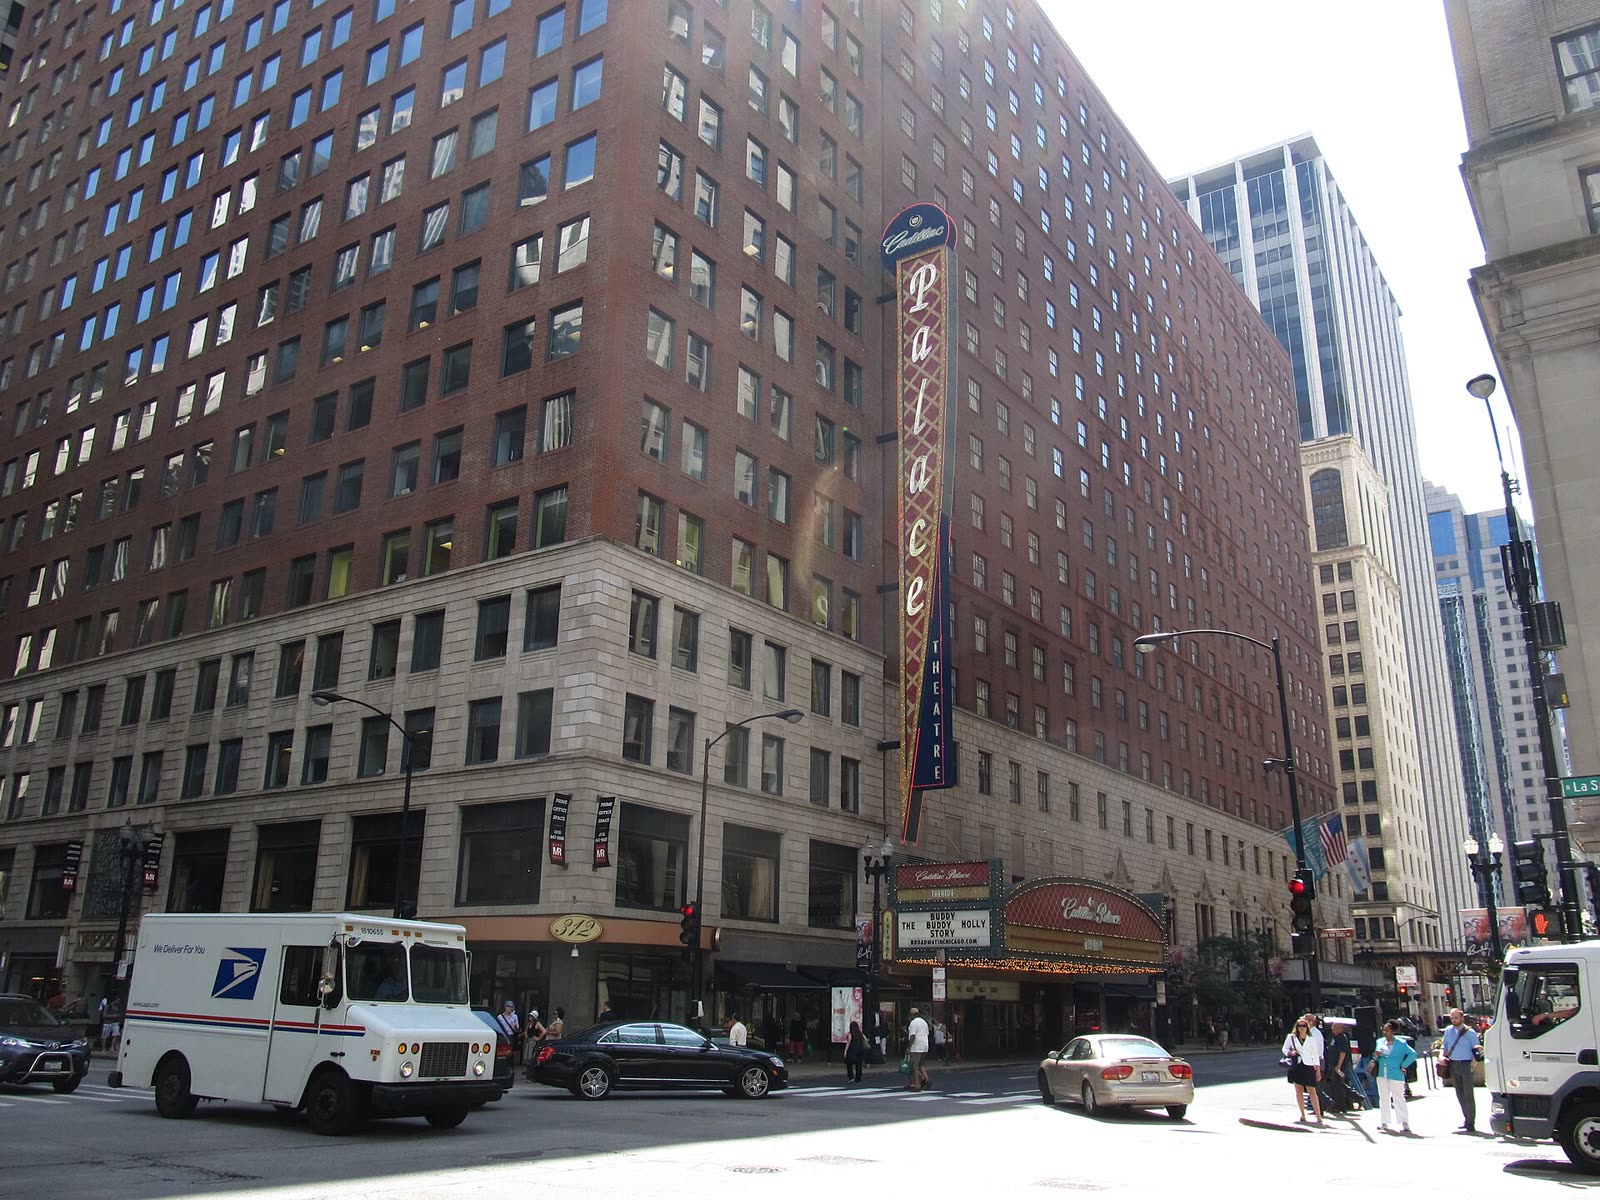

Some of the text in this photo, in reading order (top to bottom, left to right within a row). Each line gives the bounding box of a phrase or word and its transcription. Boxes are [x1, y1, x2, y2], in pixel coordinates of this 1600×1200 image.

[883, 225, 945, 254] Cadillac
[906, 264, 937, 616] Palace
[932, 640, 942, 780] THEATRE
[1573, 781, 1588, 793] La
[1590, 779, 1600, 791] S
[915, 868, 971, 881] Cadillac Palace
[930, 912, 955, 921] BUDDY
[555, 918, 597, 938] 312
[902, 919, 986, 930] THE BUDDY HOLLY
[360, 927, 384, 936] 1510655
[930, 929, 955, 938] STORY
[153, 944, 206, 954] We Deliver For You
